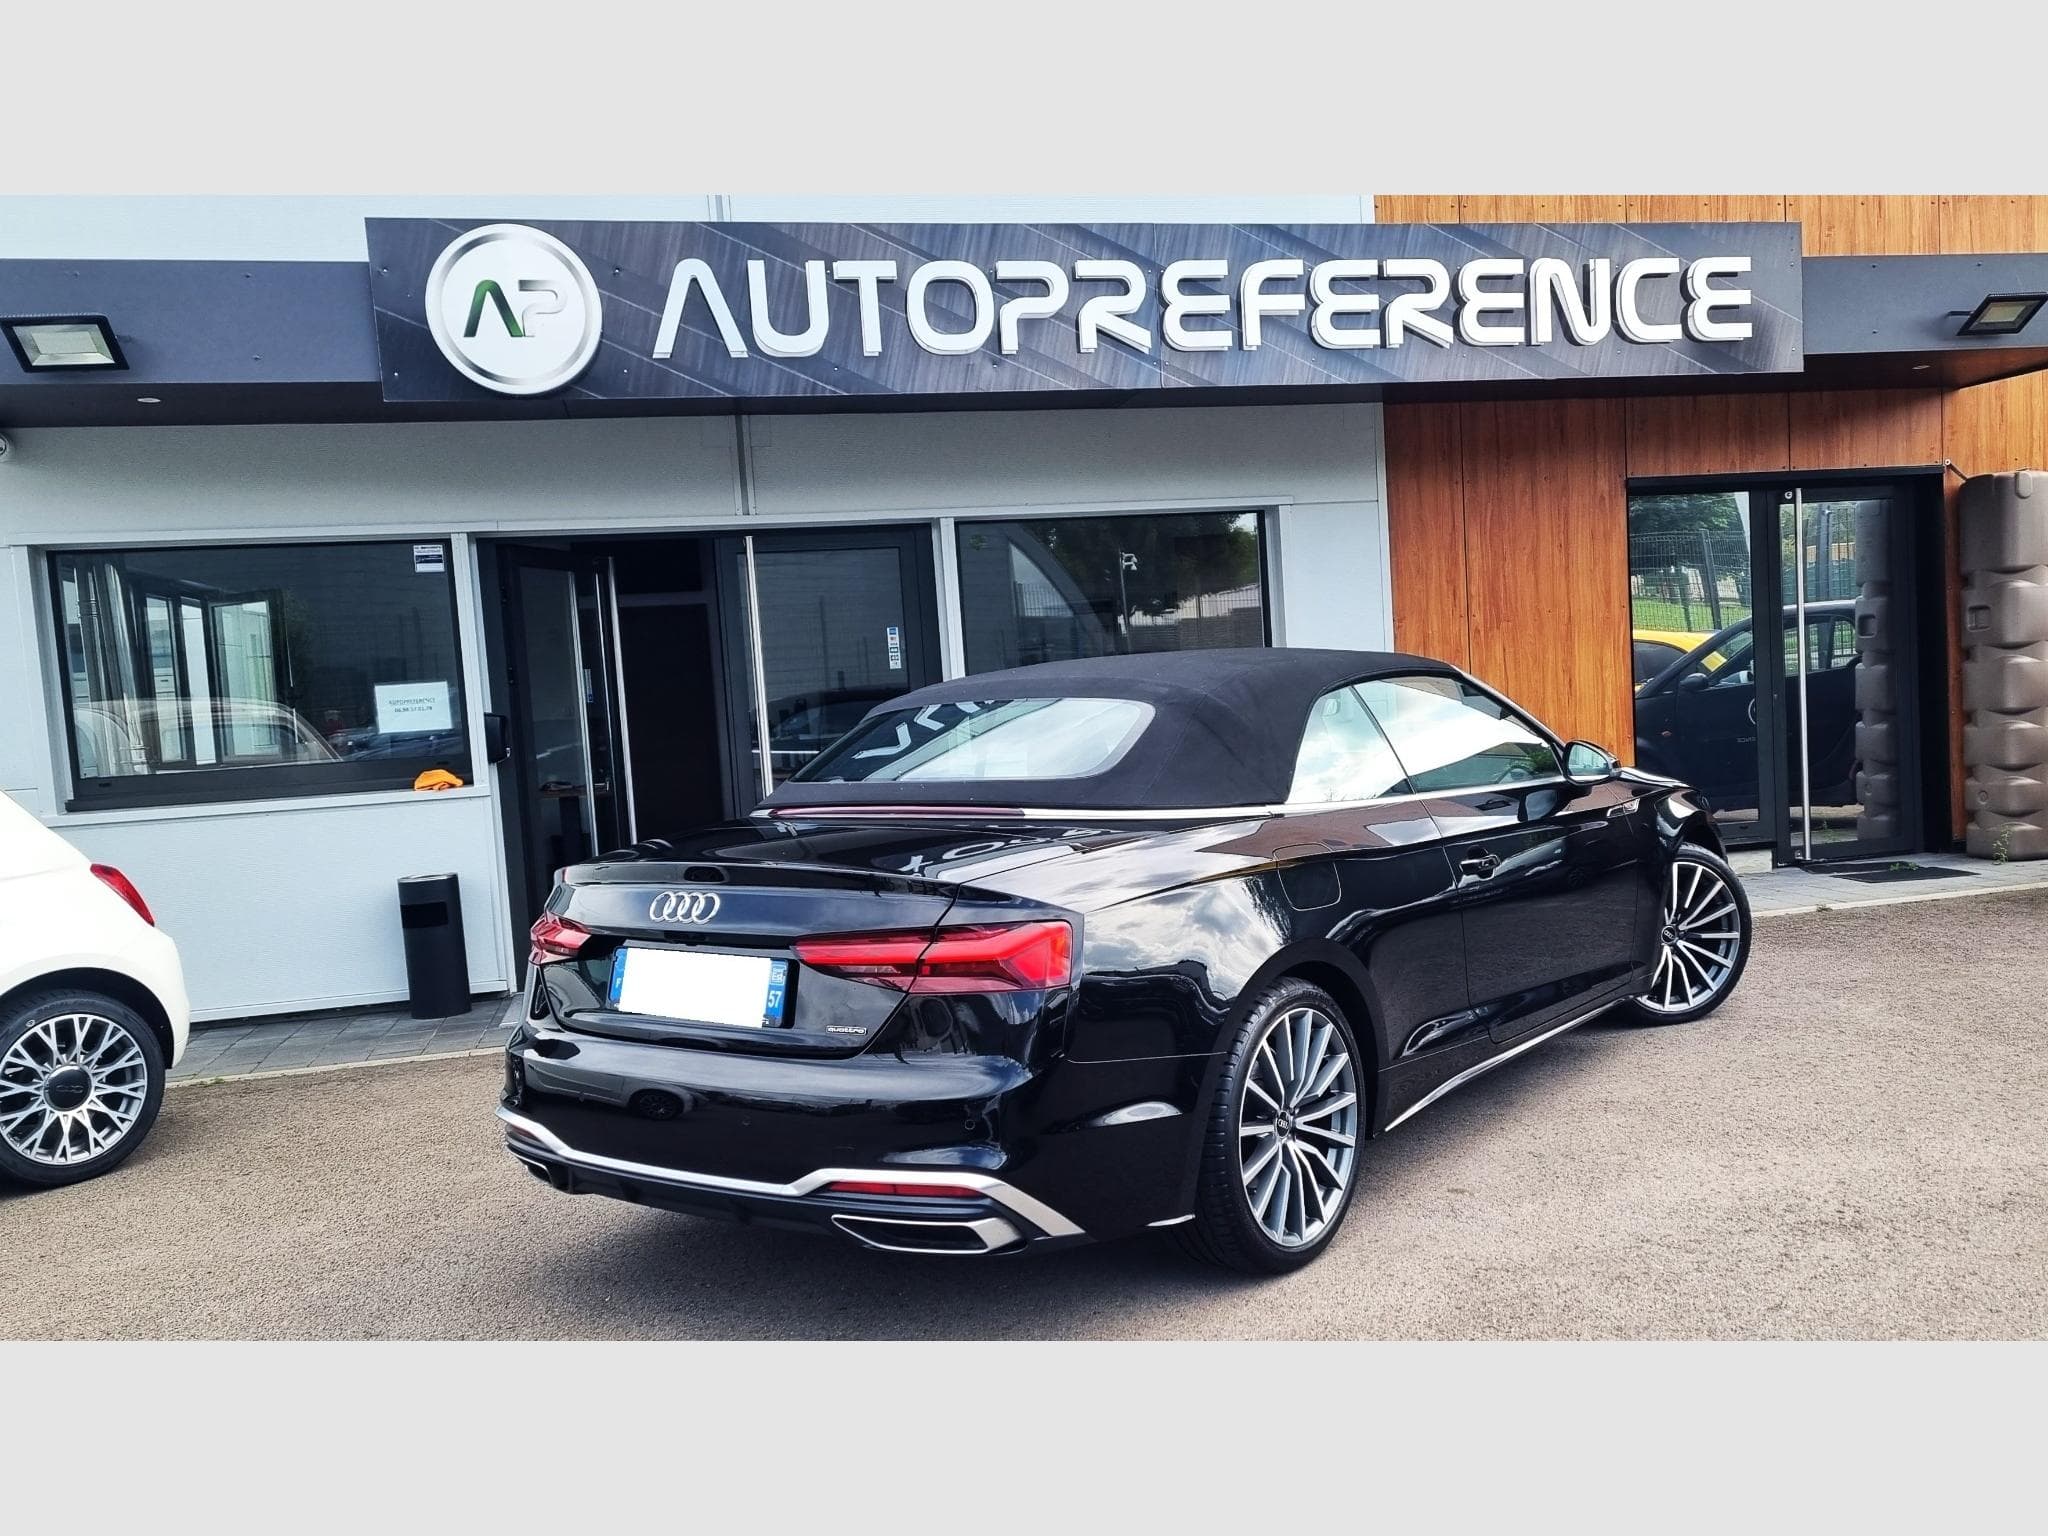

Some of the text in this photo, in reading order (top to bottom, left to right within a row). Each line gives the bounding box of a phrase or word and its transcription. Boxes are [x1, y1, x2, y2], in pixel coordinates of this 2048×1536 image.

[463, 279, 567, 338] AP
[652, 256, 1752, 358] AUTOPREFERENCE
[767, 990, 782, 1008] 57
[827, 1026, 866, 1035] quattro
